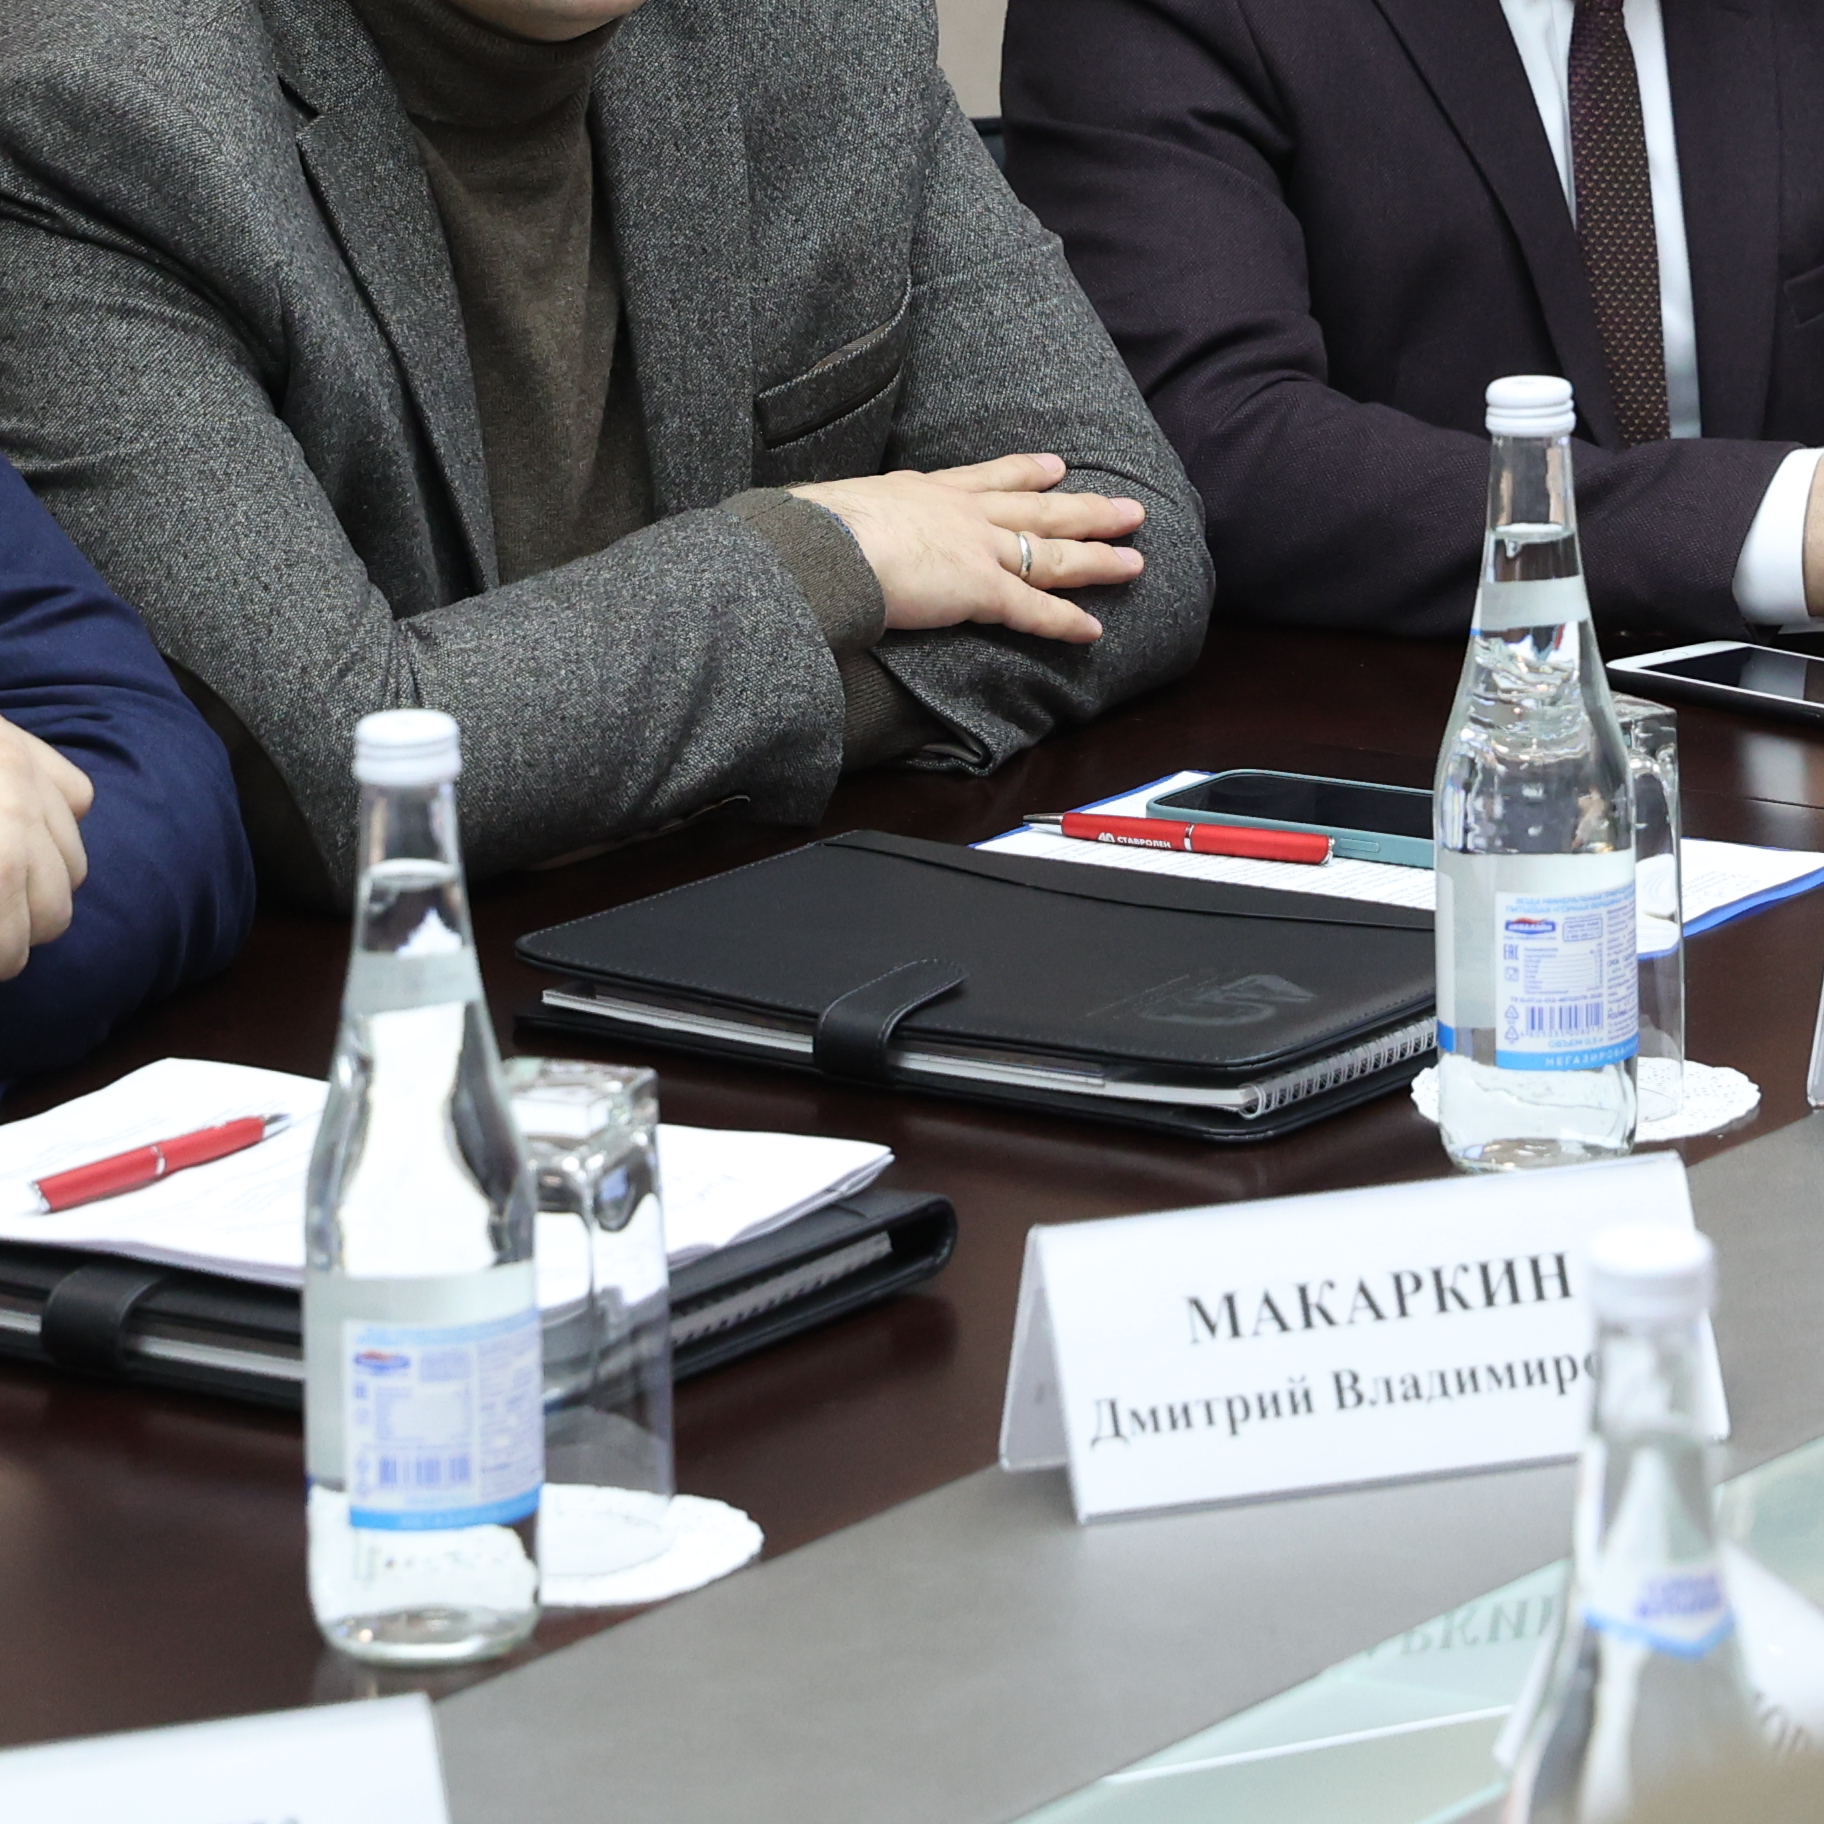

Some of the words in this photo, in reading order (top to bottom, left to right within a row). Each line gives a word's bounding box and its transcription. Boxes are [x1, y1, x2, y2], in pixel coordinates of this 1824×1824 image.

[1117, 836, 1172, 848] СТАВРОЛЕН
[1185, 1250, 1574, 1345] МАКАРКИН
[1090, 1378, 1314, 1449] Дмитрий
[1334, 1349, 1602, 1412] Владимиро
